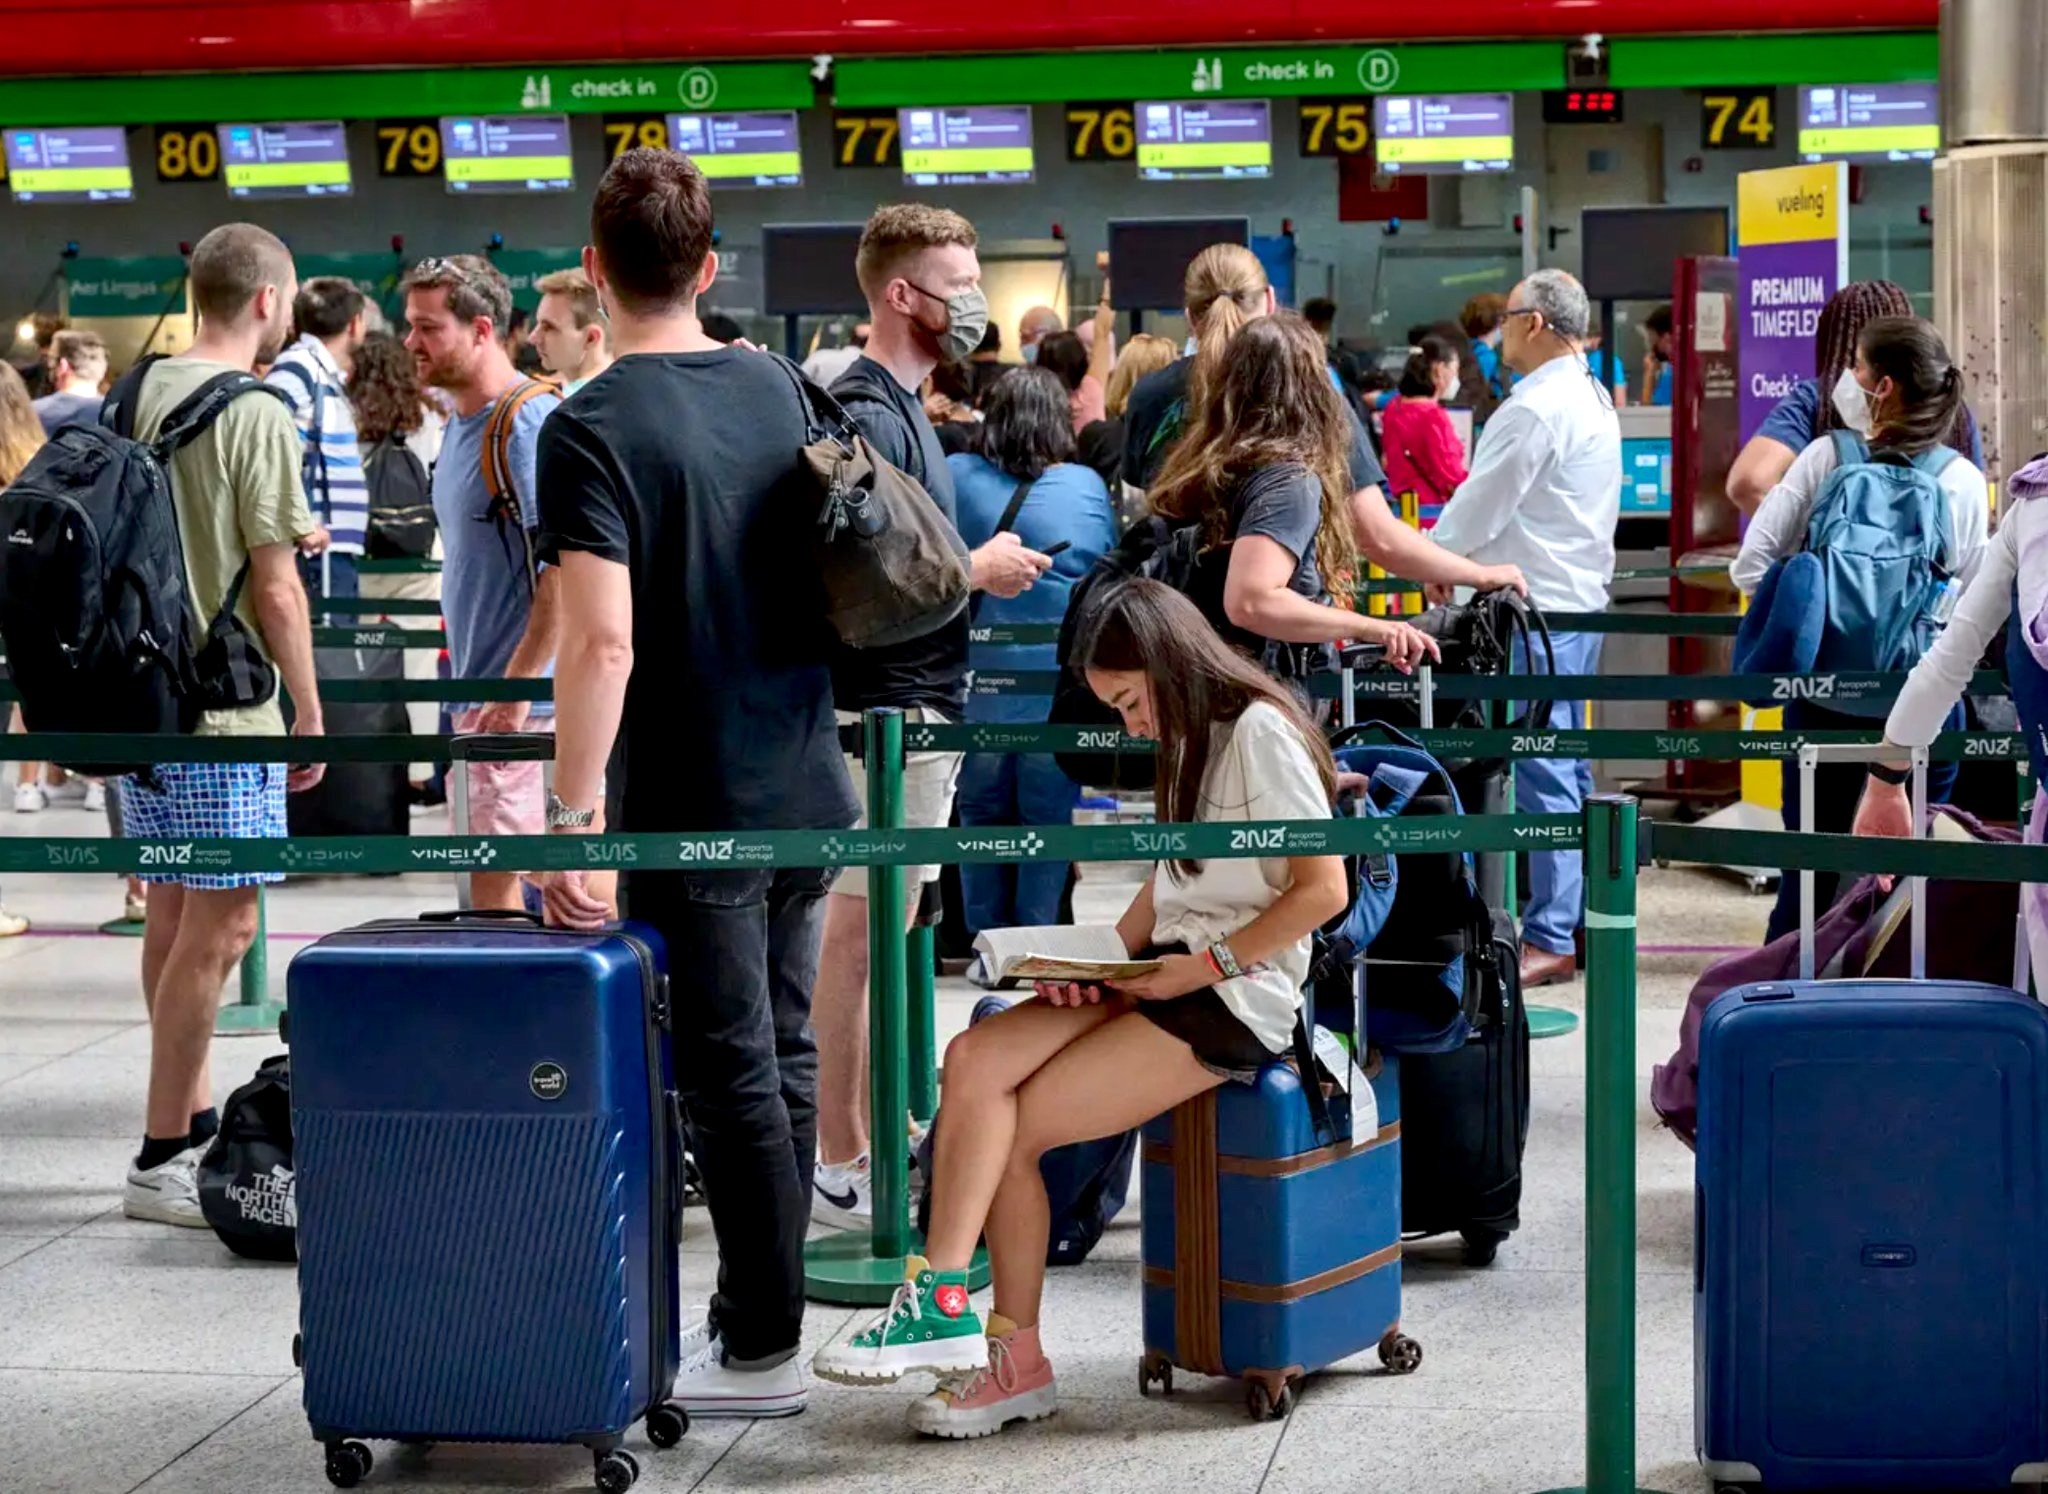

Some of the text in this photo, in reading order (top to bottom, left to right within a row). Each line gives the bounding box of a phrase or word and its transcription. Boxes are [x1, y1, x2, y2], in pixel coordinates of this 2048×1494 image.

[1244, 58, 1389, 84] check in D
[571, 75, 710, 100] check in D
[1067, 109, 1135, 157] 76
[1302, 105, 1369, 152] 75
[1704, 96, 1774, 143] 74
[378, 125, 440, 173] 79
[605, 120, 667, 157] 78
[835, 118, 898, 164] 77
[158, 130, 218, 178] 80
[1776, 185, 1825, 218] vueling
[70, 279, 157, 299] Aer Lingus
[1752, 276, 1824, 306] PREMIUM
[1739, 742, 1787, 750] VINCI
[957, 840, 1016, 850] VINCI
[1513, 826, 1575, 837] VINCI
[411, 849, 469, 859] VINCI
[225, 1183, 286, 1212] NORTH
[252, 1172, 288, 1195] THE
[241, 1202, 284, 1226] FACE
